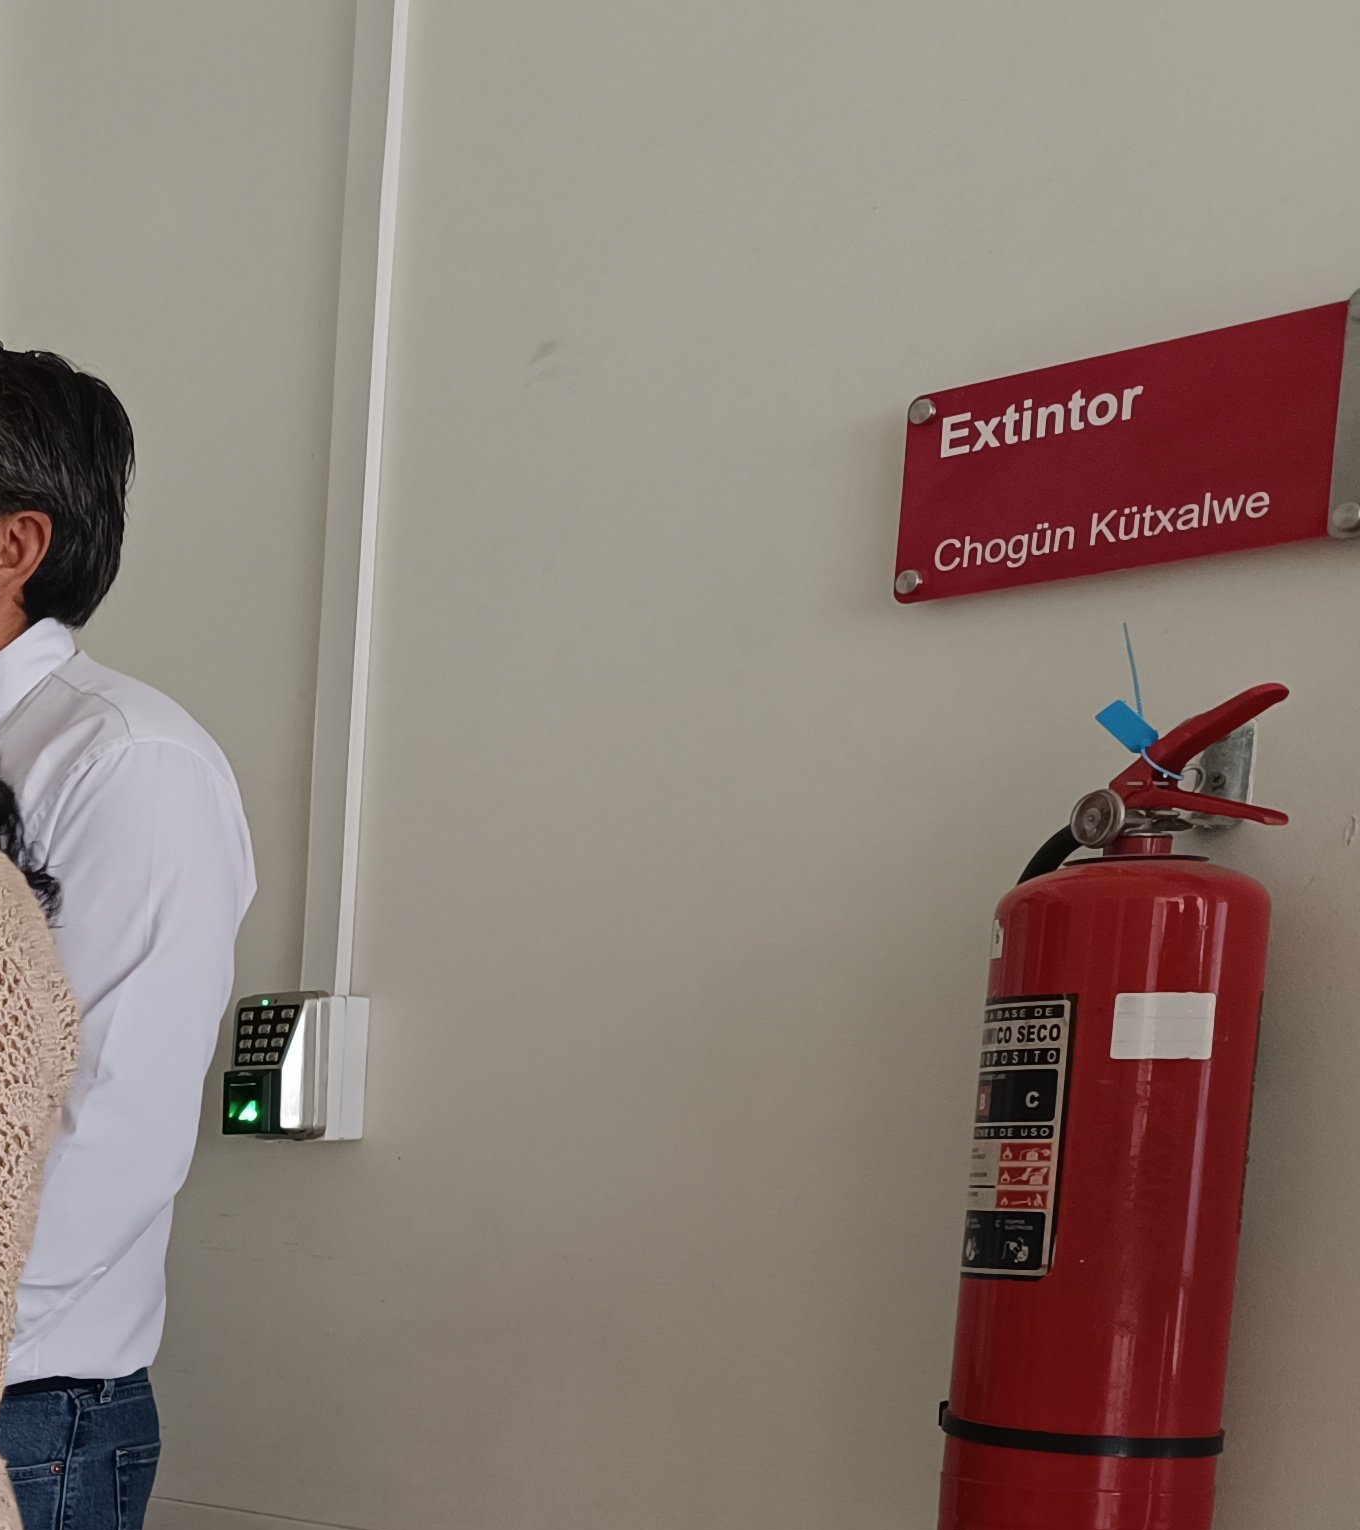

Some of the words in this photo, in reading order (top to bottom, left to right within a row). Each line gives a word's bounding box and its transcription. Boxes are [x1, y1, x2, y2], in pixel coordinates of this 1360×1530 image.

[940, 385, 1144, 459] Extintor
[933, 522, 1076, 572] Chogün
[1089, 491, 1270, 546] Kütxalwe
[1034, 1007, 1054, 1017] DE
[1016, 1023, 1061, 1043] SECO
[1025, 1090, 1040, 1108] C
[999, 1127, 1014, 1137] DE
[1020, 1127, 1050, 1137] USO
